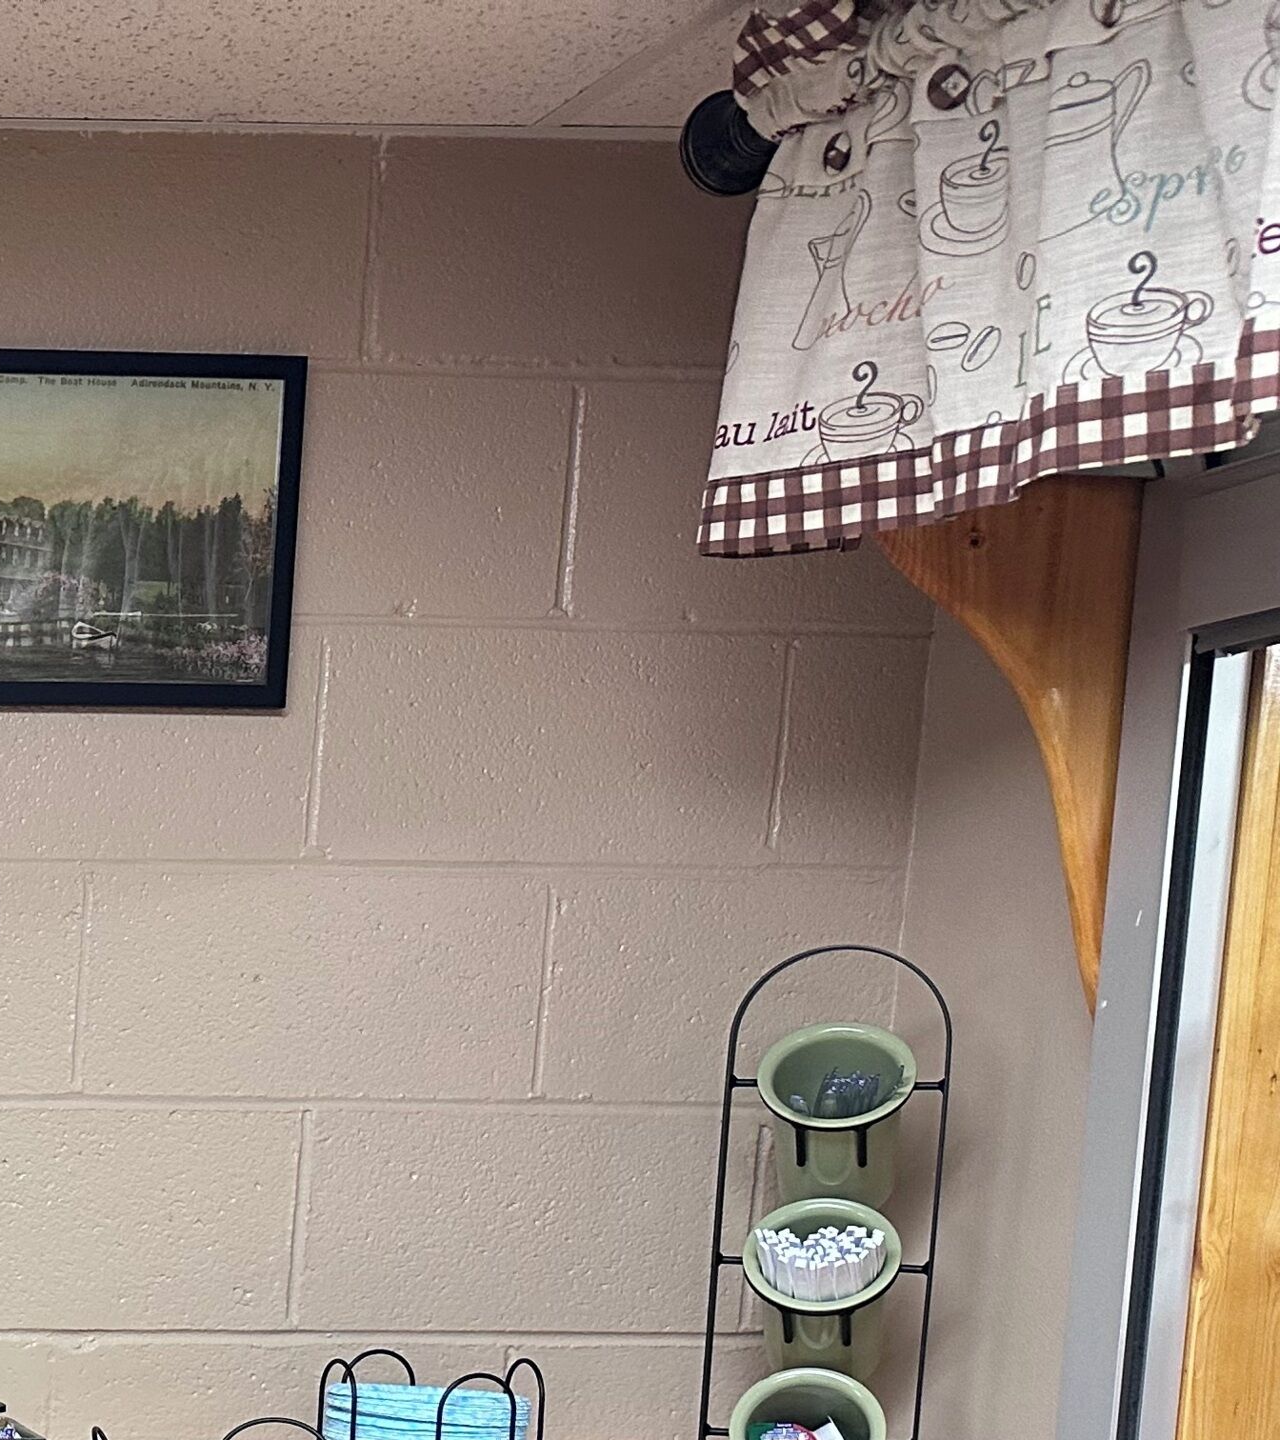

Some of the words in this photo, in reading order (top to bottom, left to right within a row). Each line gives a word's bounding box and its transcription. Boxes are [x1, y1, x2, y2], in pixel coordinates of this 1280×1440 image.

[38, 376, 56, 386] The
[60, 377, 83, 386] Boat
[87, 378, 117, 387] House
[130, 379, 187, 389] Adirondack
[714, 422, 754, 449] au
[763, 400, 817, 442] lait
